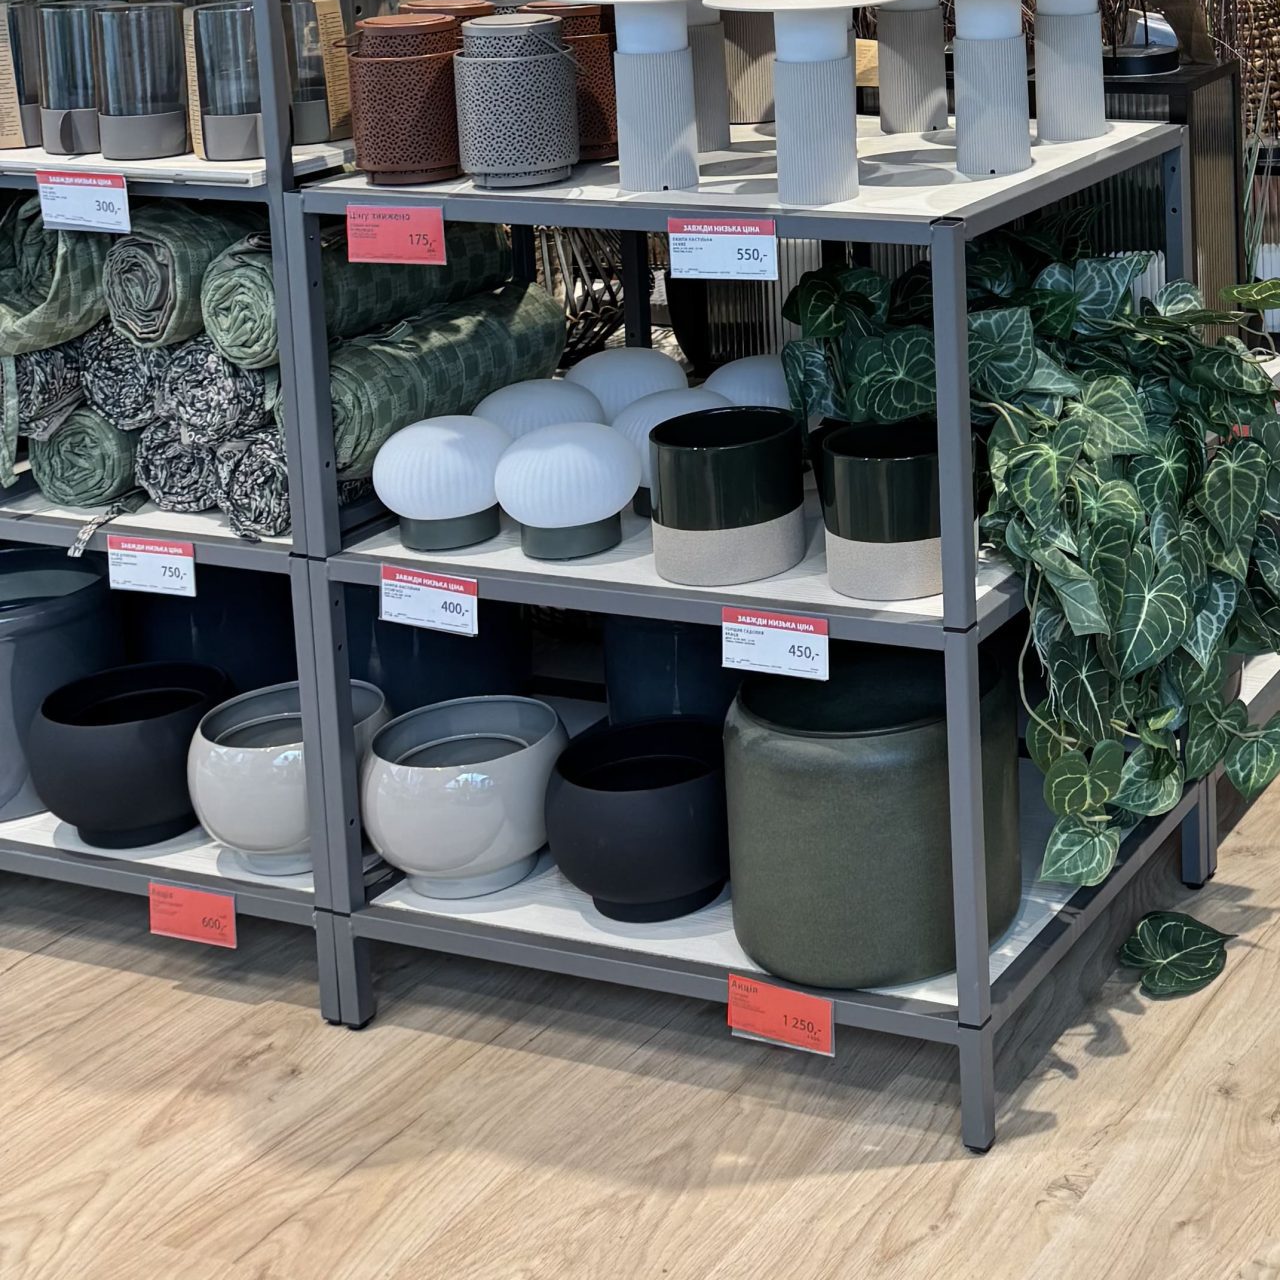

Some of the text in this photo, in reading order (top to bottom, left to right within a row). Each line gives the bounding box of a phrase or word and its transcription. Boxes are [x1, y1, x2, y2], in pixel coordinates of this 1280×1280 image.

[95, 200, 121, 215] 300,-
[683, 224, 760, 234] ЗАВЖДИ НИЗЬКА ЦІНА
[409, 233, 437, 247] 175,-
[737, 248, 768, 263] 550,-
[161, 566, 187, 580] 750,-
[395, 573, 465, 592] ЗАВЖДИ НИЗЬКА ЦІНА
[441, 601, 469, 617] 400,-
[737, 615, 815, 632] ЗАВЖДИ НИЗЬКА ЦІНА
[788, 644, 820, 661] 450,-
[202, 917, 228, 932] 600,-
[731, 980, 758, 993] Акція
